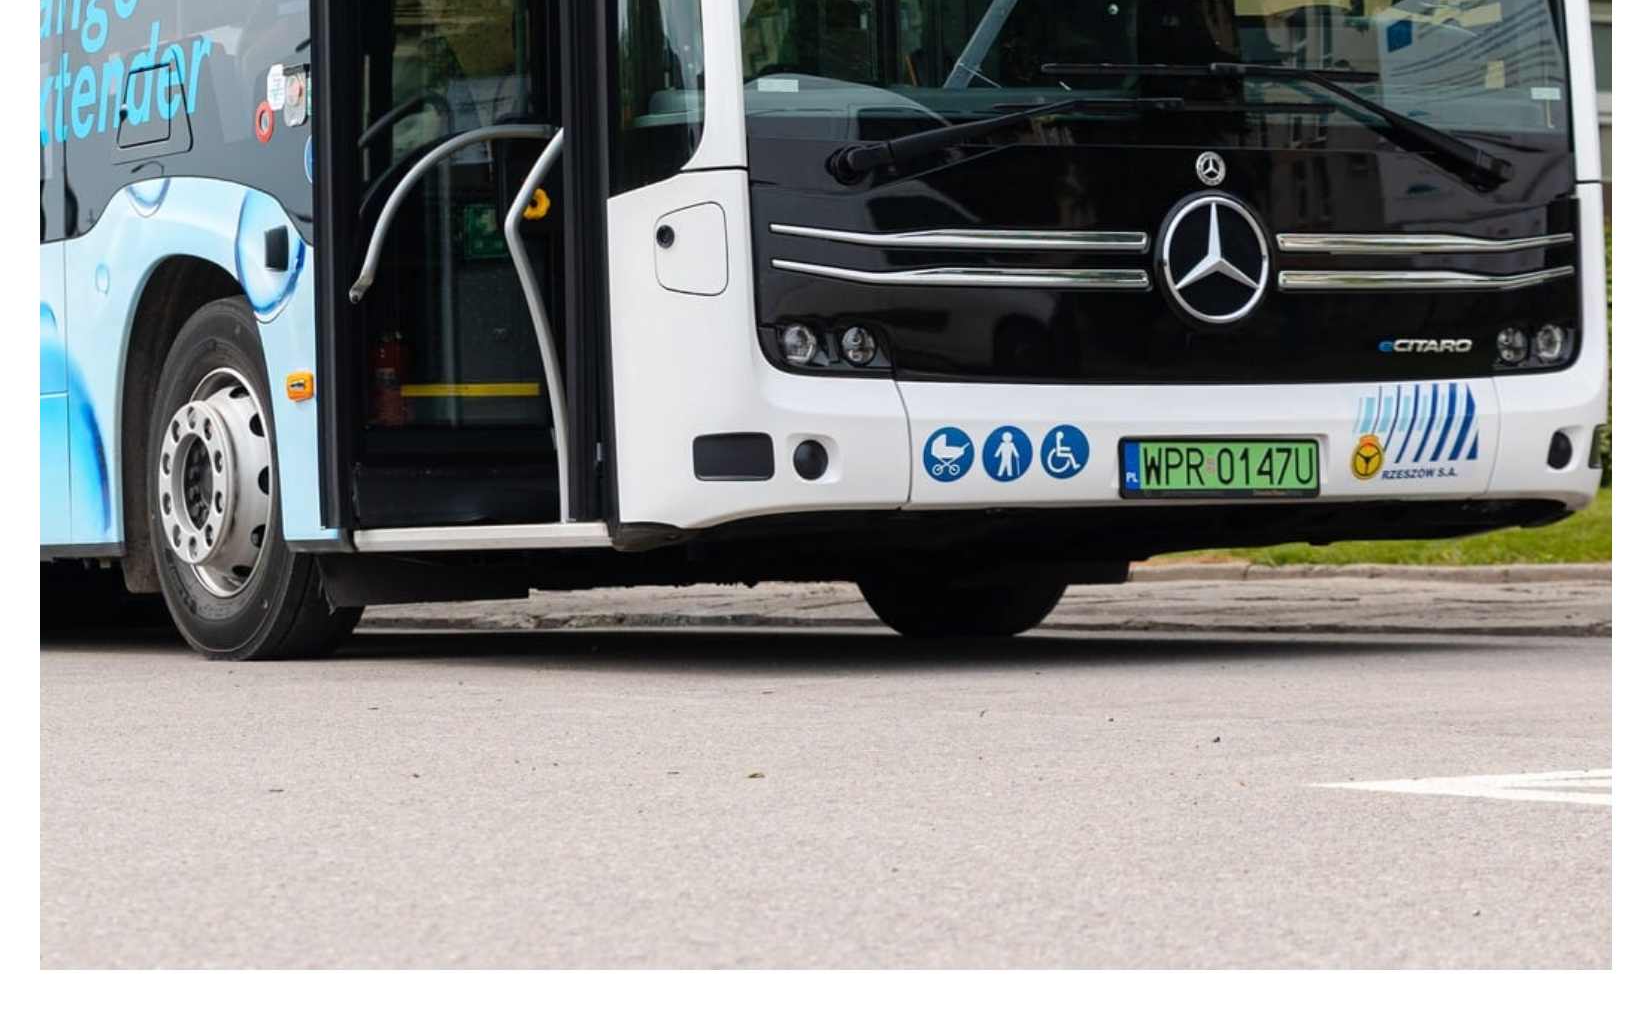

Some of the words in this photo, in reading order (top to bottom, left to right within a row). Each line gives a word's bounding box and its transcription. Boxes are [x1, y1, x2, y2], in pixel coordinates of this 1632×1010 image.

[1378, 338, 1474, 353] eCITARO
[1143, 447, 1205, 486] WPR
[1217, 446, 1314, 486] 0147U
[1125, 471, 1139, 483] PL
